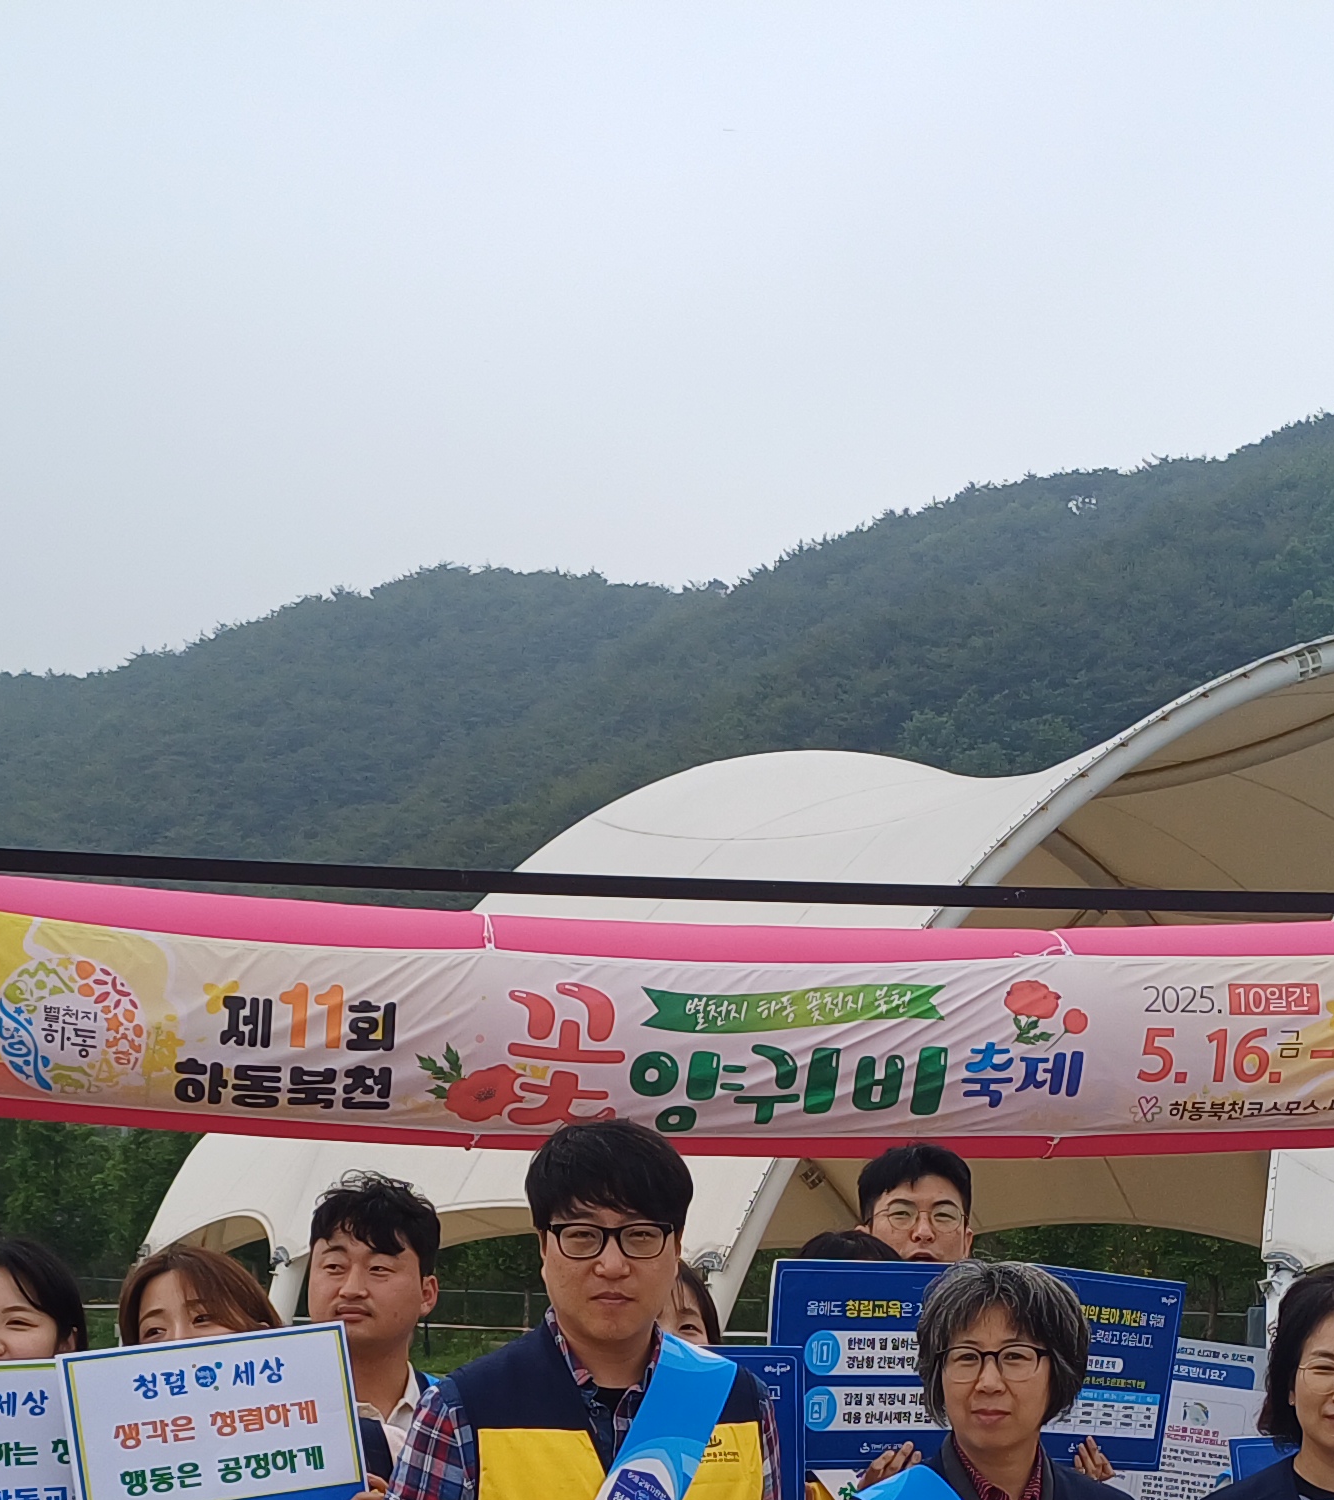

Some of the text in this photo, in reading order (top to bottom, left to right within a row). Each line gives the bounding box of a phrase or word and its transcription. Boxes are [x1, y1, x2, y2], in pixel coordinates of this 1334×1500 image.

[43, 1004, 98, 1028] 별천지
[219, 982, 396, 1053] 제11회
[685, 985, 913, 1031] 별천지 하동 꽃천지 북천
[1142, 984, 1312, 1015] 2025. 10일간
[40, 1024, 98, 1059] 하동
[173, 1056, 394, 1110] 하동북천
[961, 1041, 1084, 1109] 축제
[806, 1300, 843, 1317] 올해도
[132, 1356, 285, 1400] 청렴 세상
[113, 1399, 319, 1450] 생각은 청렴하게
[119, 1445, 325, 1497] 행동은 공정하게
